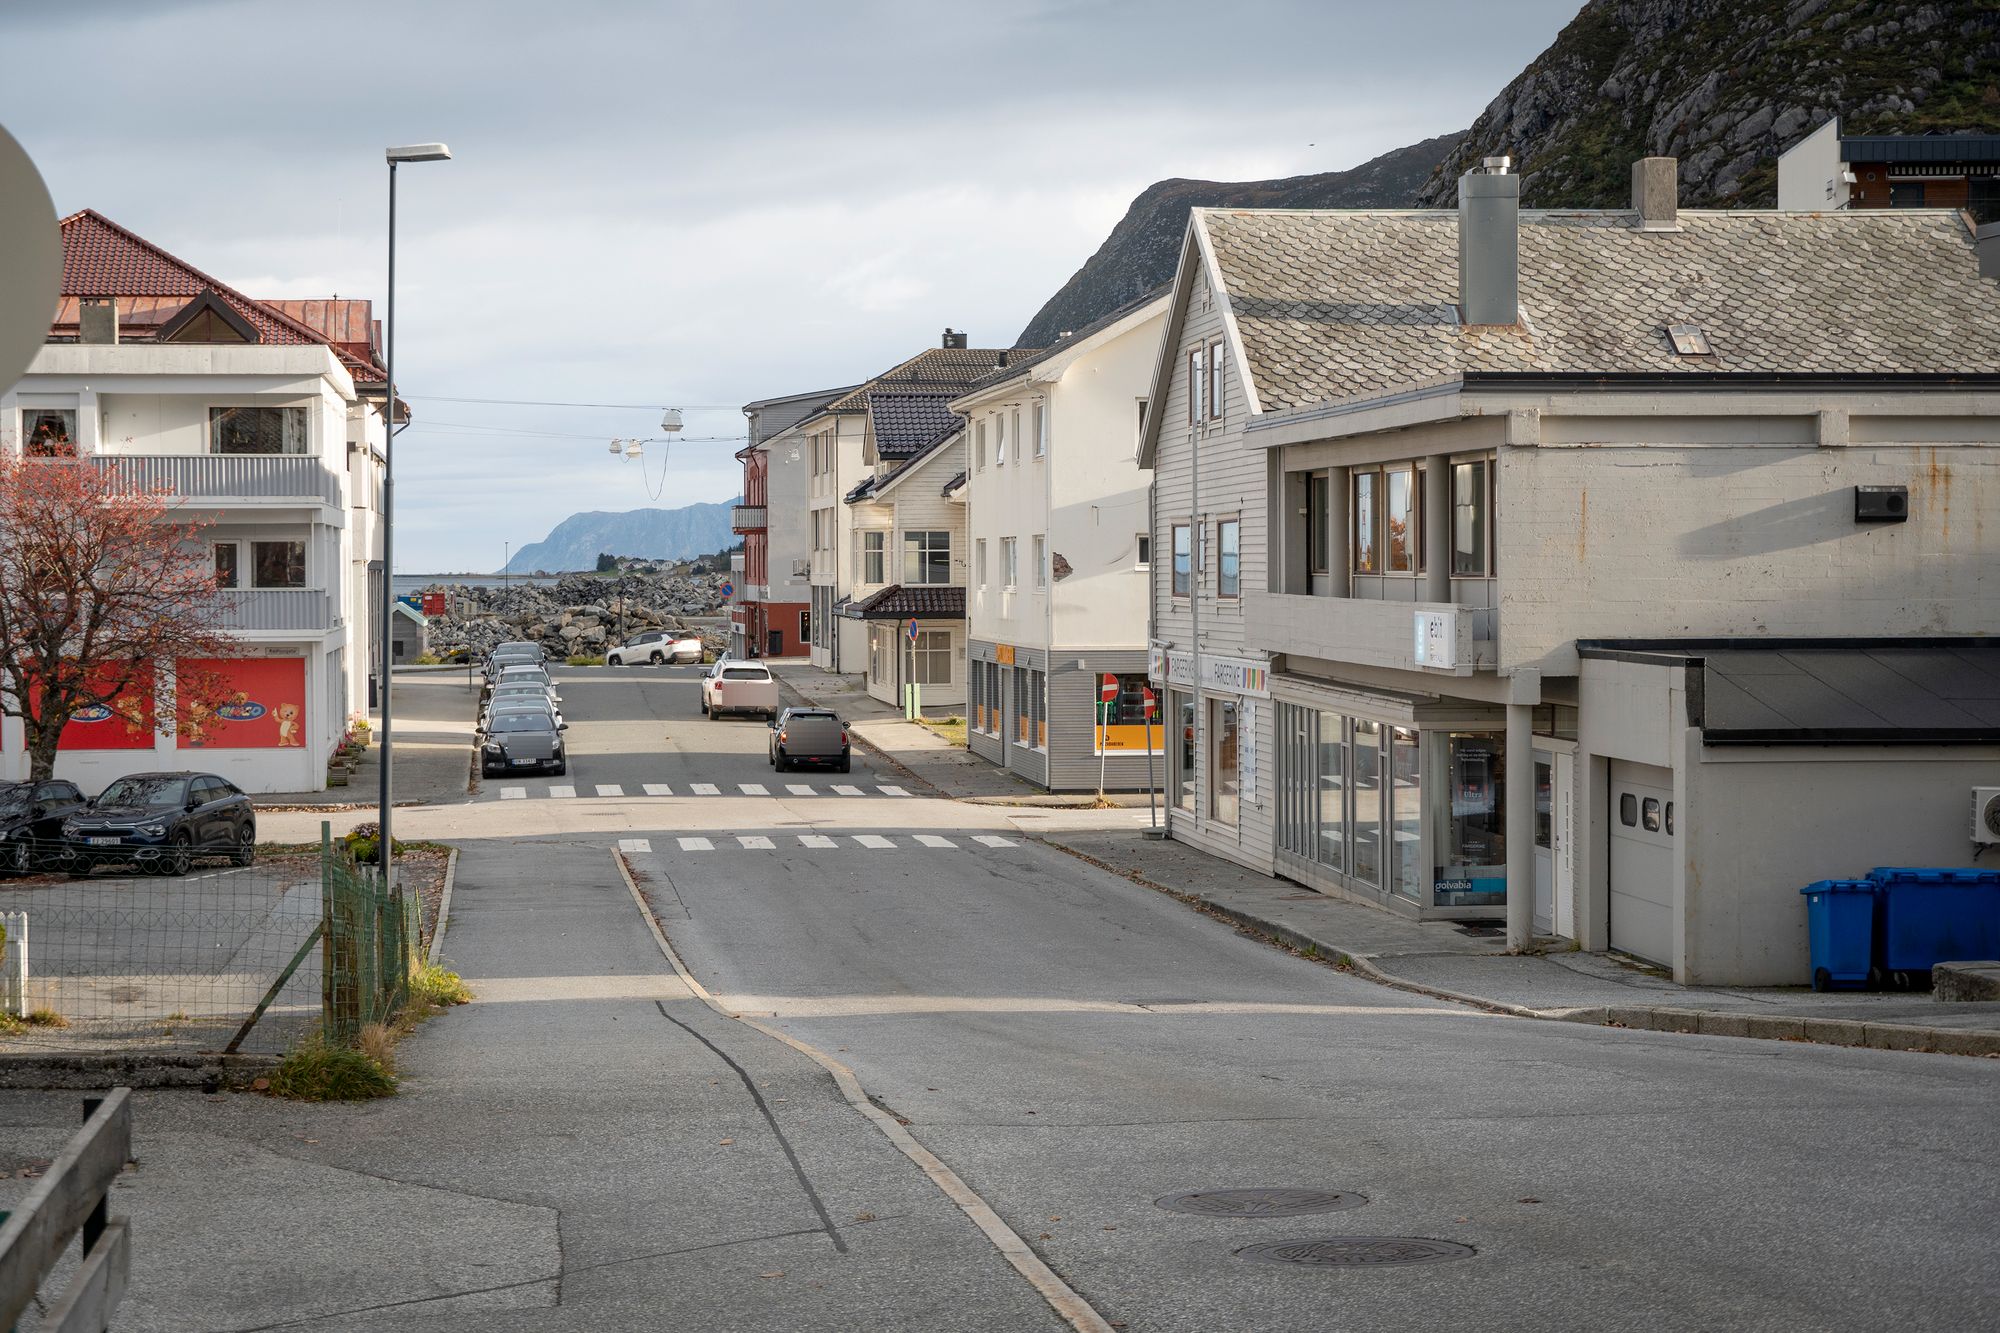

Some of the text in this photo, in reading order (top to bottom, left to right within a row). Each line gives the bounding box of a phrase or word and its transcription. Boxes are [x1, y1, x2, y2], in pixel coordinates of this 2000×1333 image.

[1214, 663, 1240, 688] FARGERIKE
[1464, 790, 1483, 799] Ultra
[1434, 880, 1472, 892] golvabia
